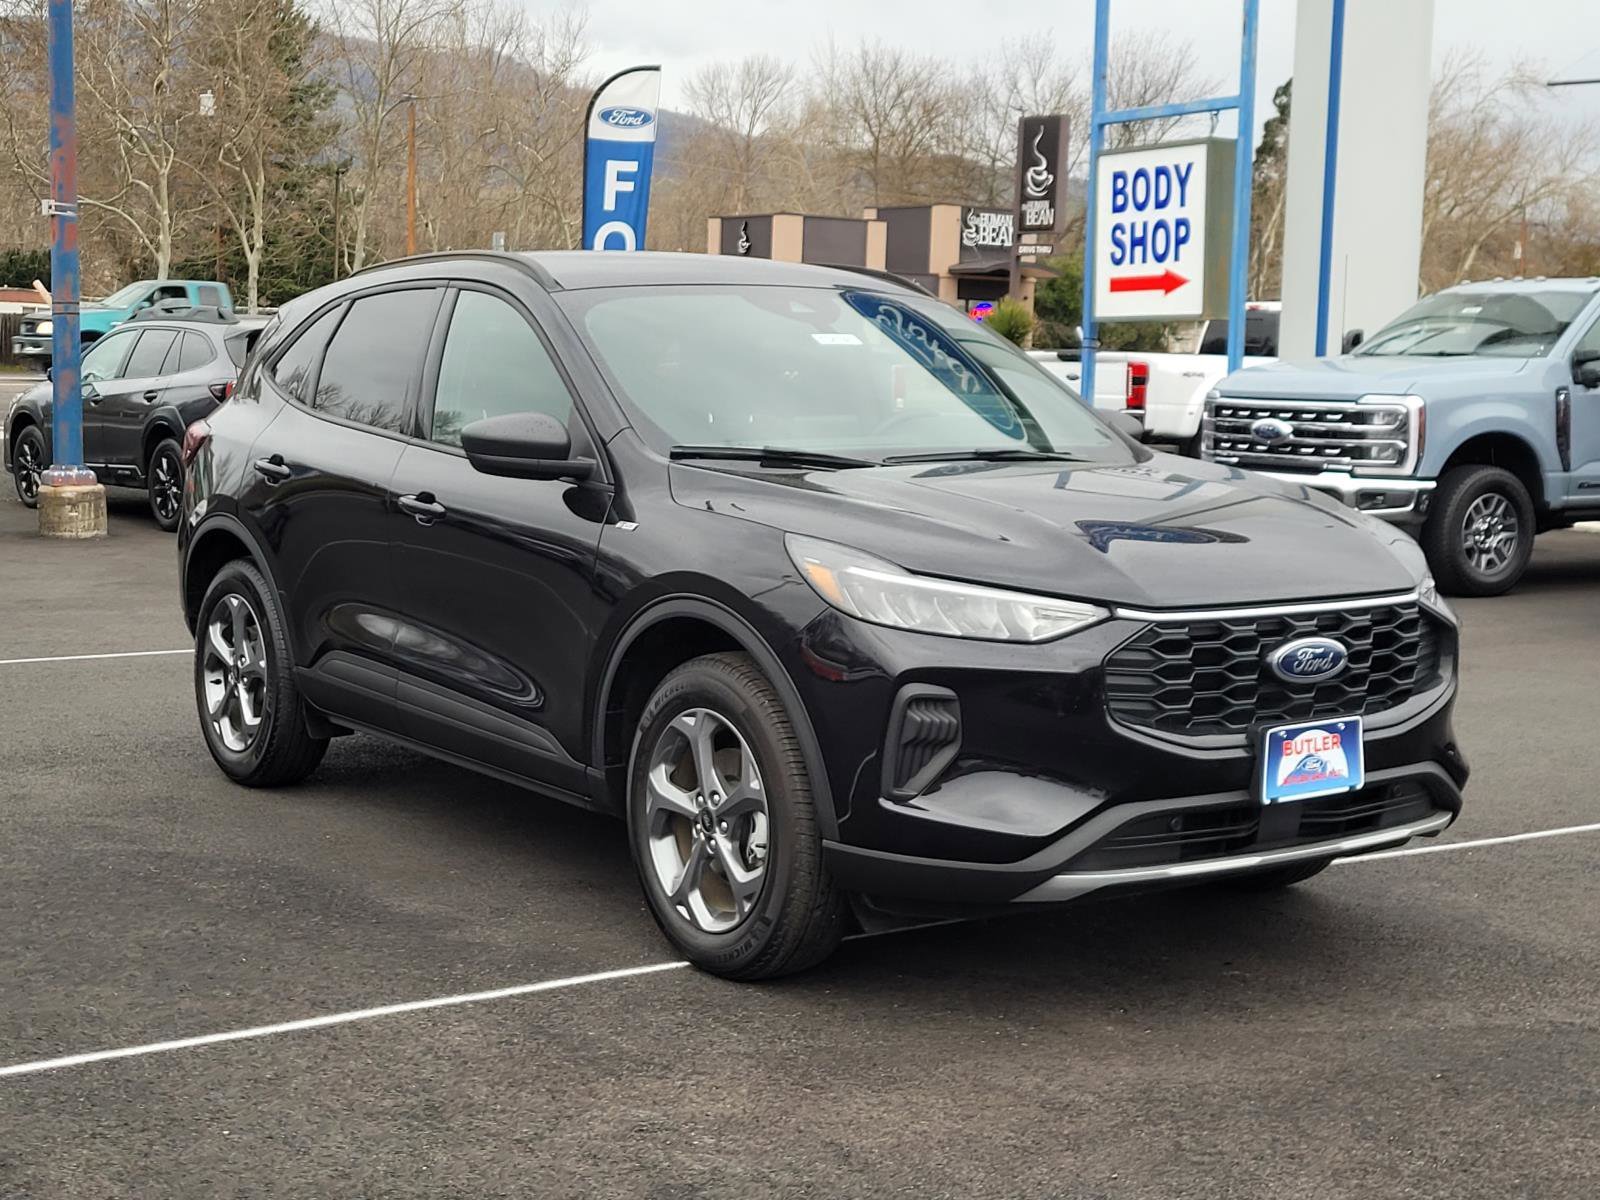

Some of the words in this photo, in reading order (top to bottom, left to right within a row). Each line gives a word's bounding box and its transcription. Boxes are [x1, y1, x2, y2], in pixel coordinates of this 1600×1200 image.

[608, 109, 644, 126] Ford
[1112, 162, 1194, 214] BODY
[1025, 208, 1055, 226] BEAN
[1110, 217, 1191, 267] SHOP
[1293, 647, 1334, 673] Ford
[1282, 733, 1341, 757] BUTLER
